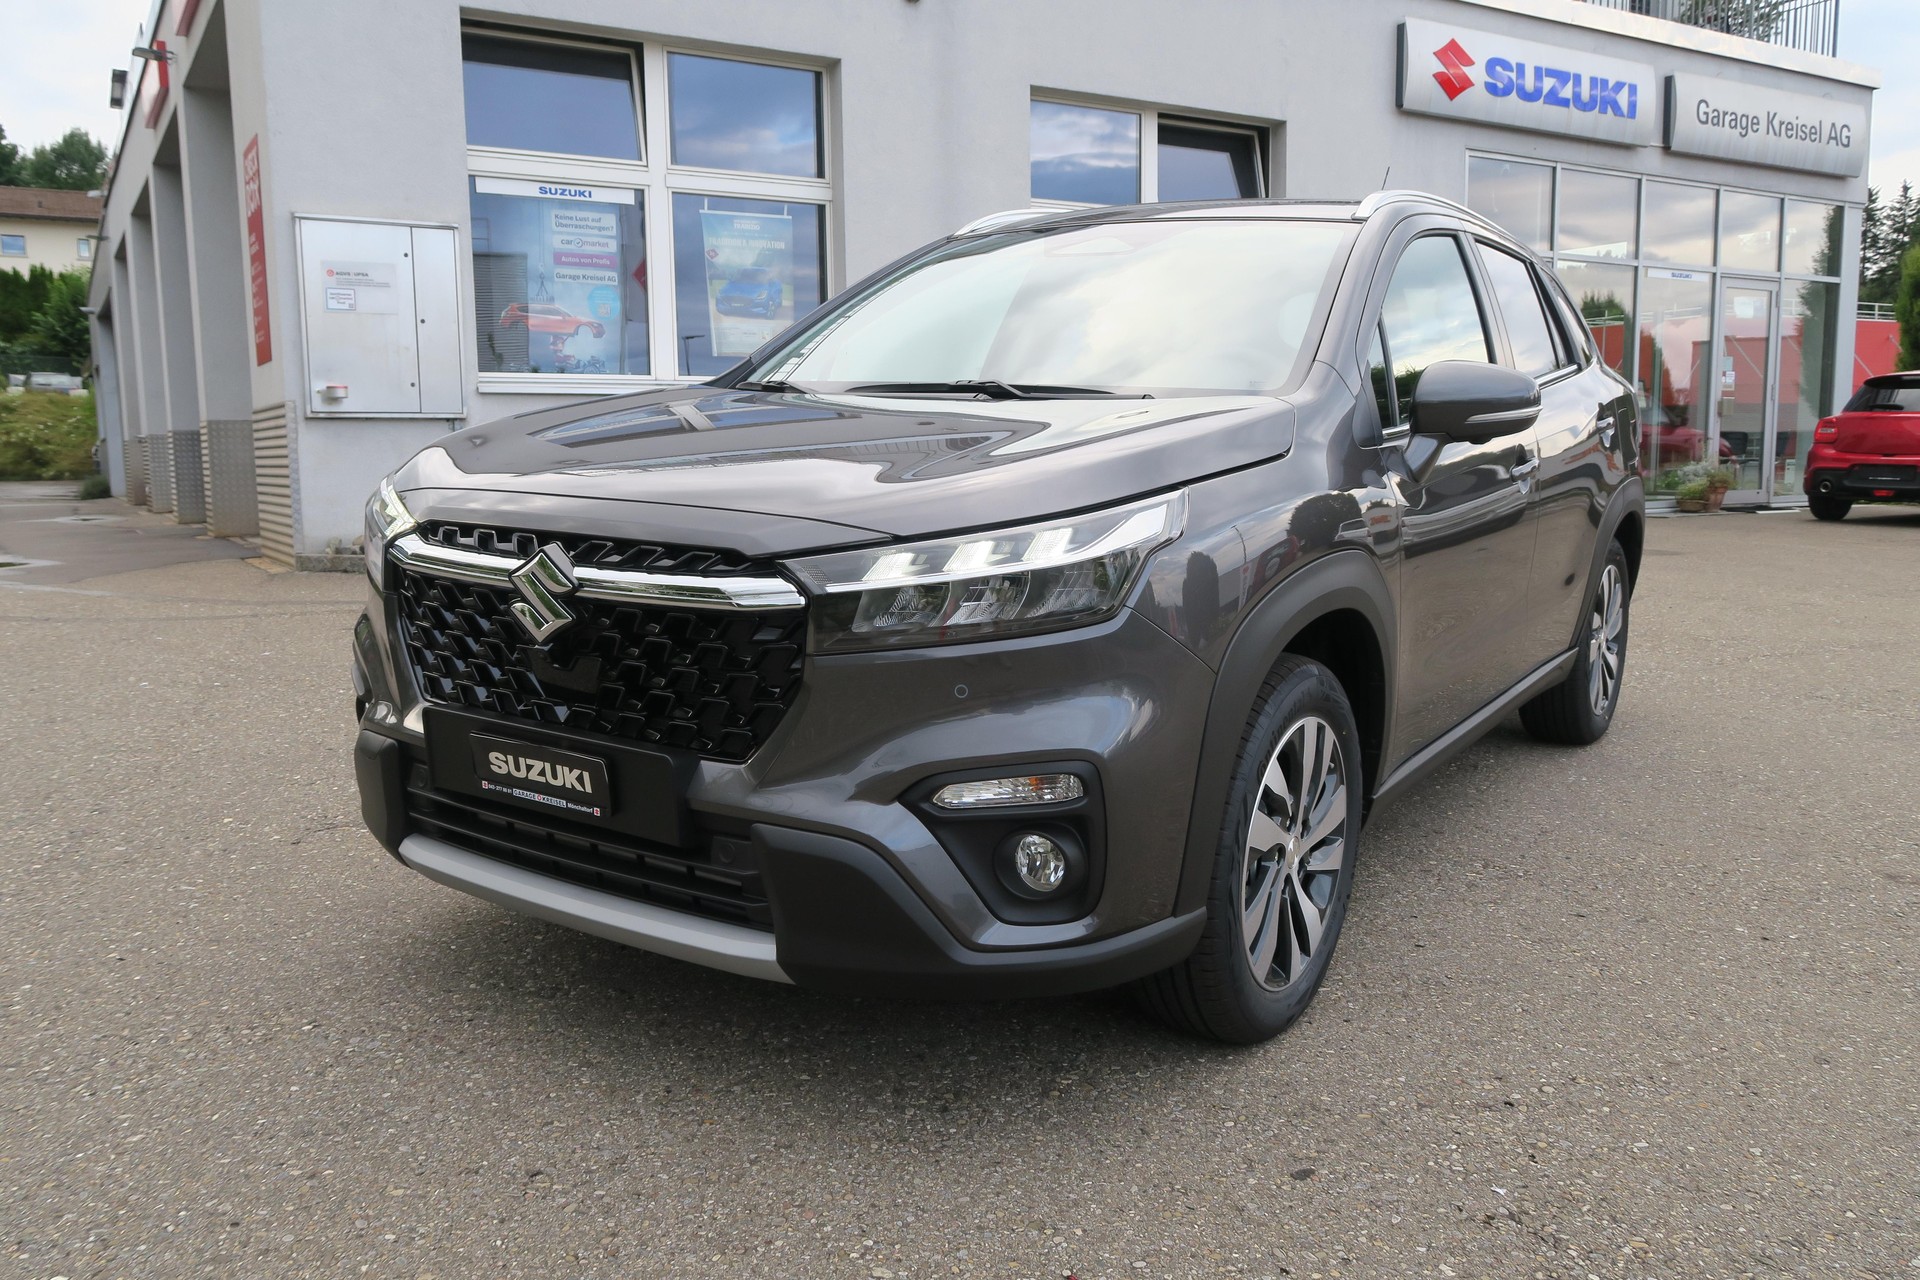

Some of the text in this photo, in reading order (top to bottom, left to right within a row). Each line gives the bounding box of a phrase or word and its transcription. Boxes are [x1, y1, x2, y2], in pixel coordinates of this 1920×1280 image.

[1484, 57, 1638, 119] SUZUKI
[1696, 99, 1851, 148] Garage Kreisel AG
[538, 186, 592, 198] SUZUKI
[554, 213, 574, 221] Keine
[554, 220, 614, 232] Überraschungen?
[555, 272, 581, 281] Garage
[581, 274, 606, 282] Kreisel
[488, 751, 593, 793] SUZUKI
[513, 789, 537, 800] GARAGE
